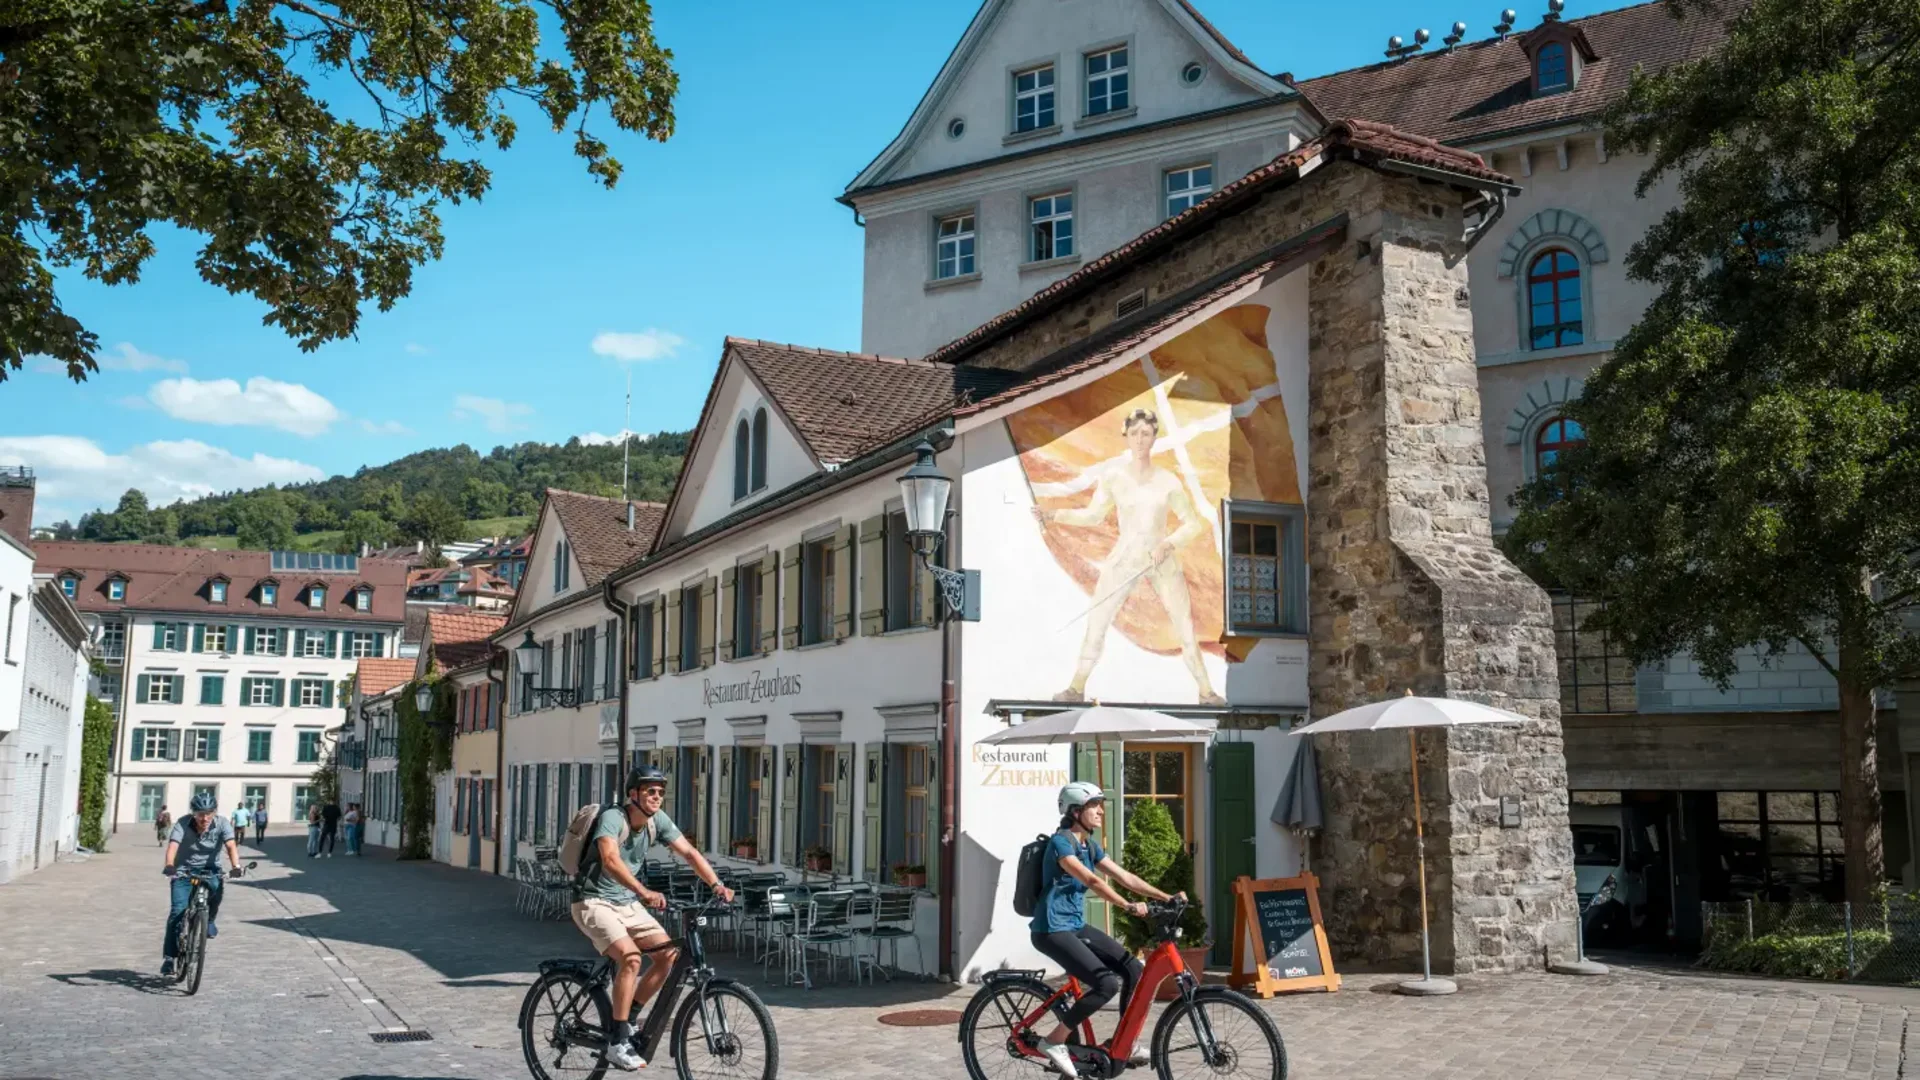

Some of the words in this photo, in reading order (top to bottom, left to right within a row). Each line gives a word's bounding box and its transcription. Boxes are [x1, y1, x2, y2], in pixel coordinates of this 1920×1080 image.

[703, 678, 750, 708] Restaurant
[750, 667, 802, 704] Zeughaus
[972, 744, 1049, 763] Restaurant
[980, 764, 1069, 787] ZEUGHAUS
